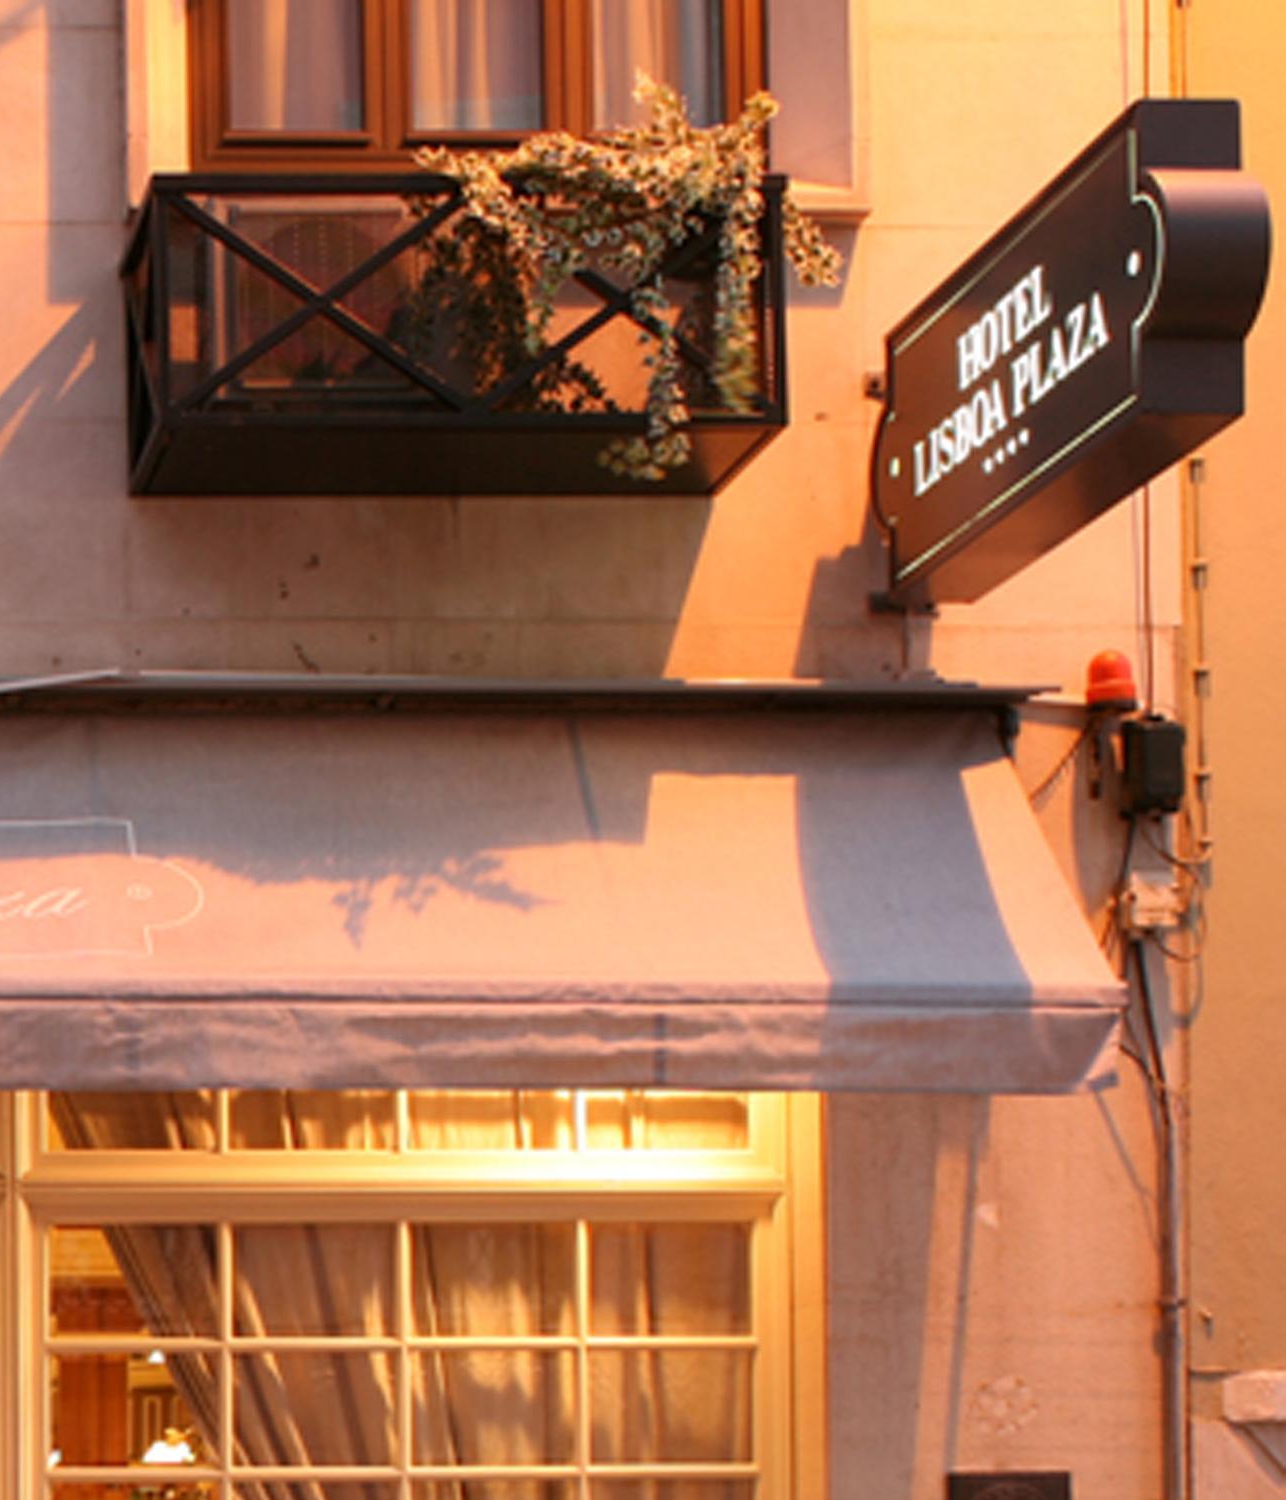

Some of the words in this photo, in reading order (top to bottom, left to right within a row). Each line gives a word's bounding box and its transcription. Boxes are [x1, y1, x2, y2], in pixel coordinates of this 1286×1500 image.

[914, 379, 1007, 496] LISBOA
[1011, 291, 1109, 417] PLAZA
[957, 264, 1052, 392] HOTEL
